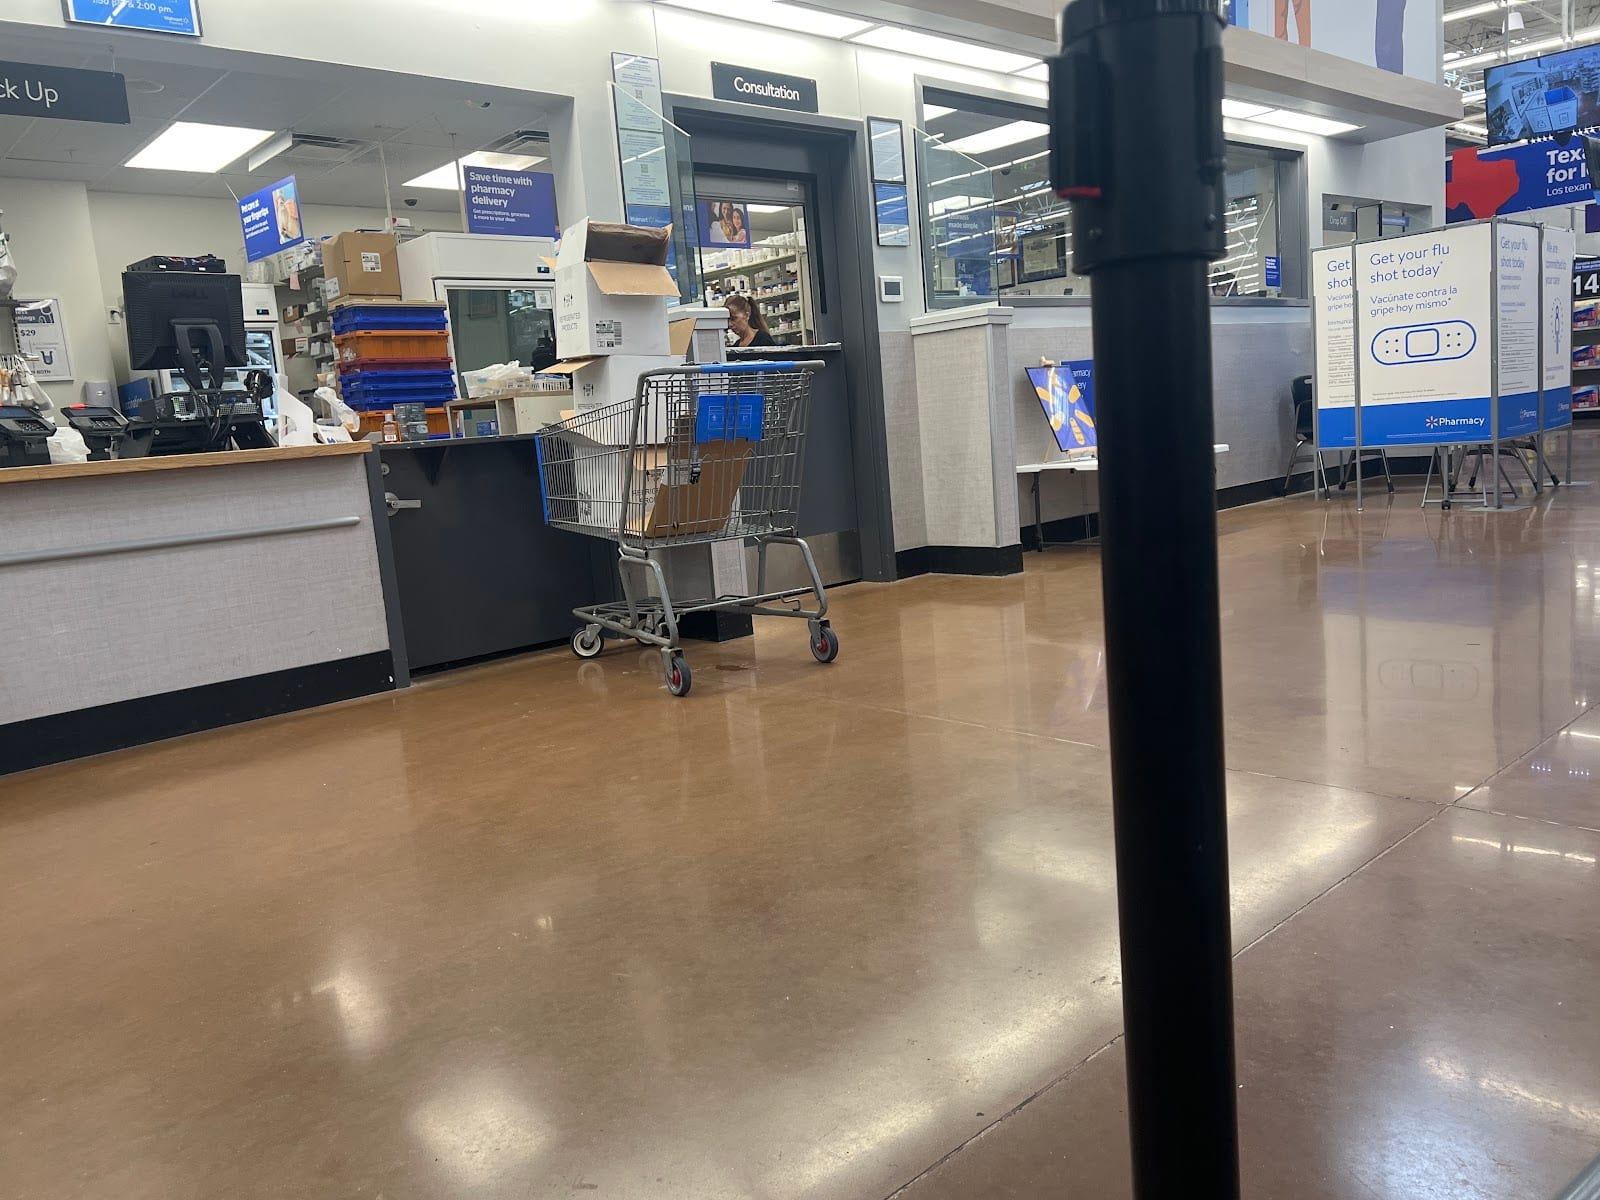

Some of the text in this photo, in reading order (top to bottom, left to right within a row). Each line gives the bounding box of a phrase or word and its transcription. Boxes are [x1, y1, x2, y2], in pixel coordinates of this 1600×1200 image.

[136, 1, 157, 11] 2:00
[25, 80, 59, 108] Up
[734, 76, 800, 101] Consultation
[469, 172, 533, 186] Save time with
[1546, 167, 1577, 184] for
[471, 184, 515, 197] pharmacy
[1547, 187, 1564, 197] Los
[472, 195, 508, 208] delivery
[1329, 215, 1348, 226] Drop Off
[1501, 236, 1510, 249] Get
[1510, 240, 1522, 252] your
[1370, 243, 1450, 266] Get your flu
[1327, 259, 1351, 273] Get
[1327, 277, 1353, 290] shot
[1370, 269, 1398, 284] shot
[1573, 273, 1600, 295] 14
[1370, 285, 1457, 304] Vacúnate contra la
[1370, 306, 1394, 318] gripe
[1396, 302, 1413, 313] hoy
[20, 329, 36, 337] $29
[1439, 415, 1485, 426] Pharmacy
